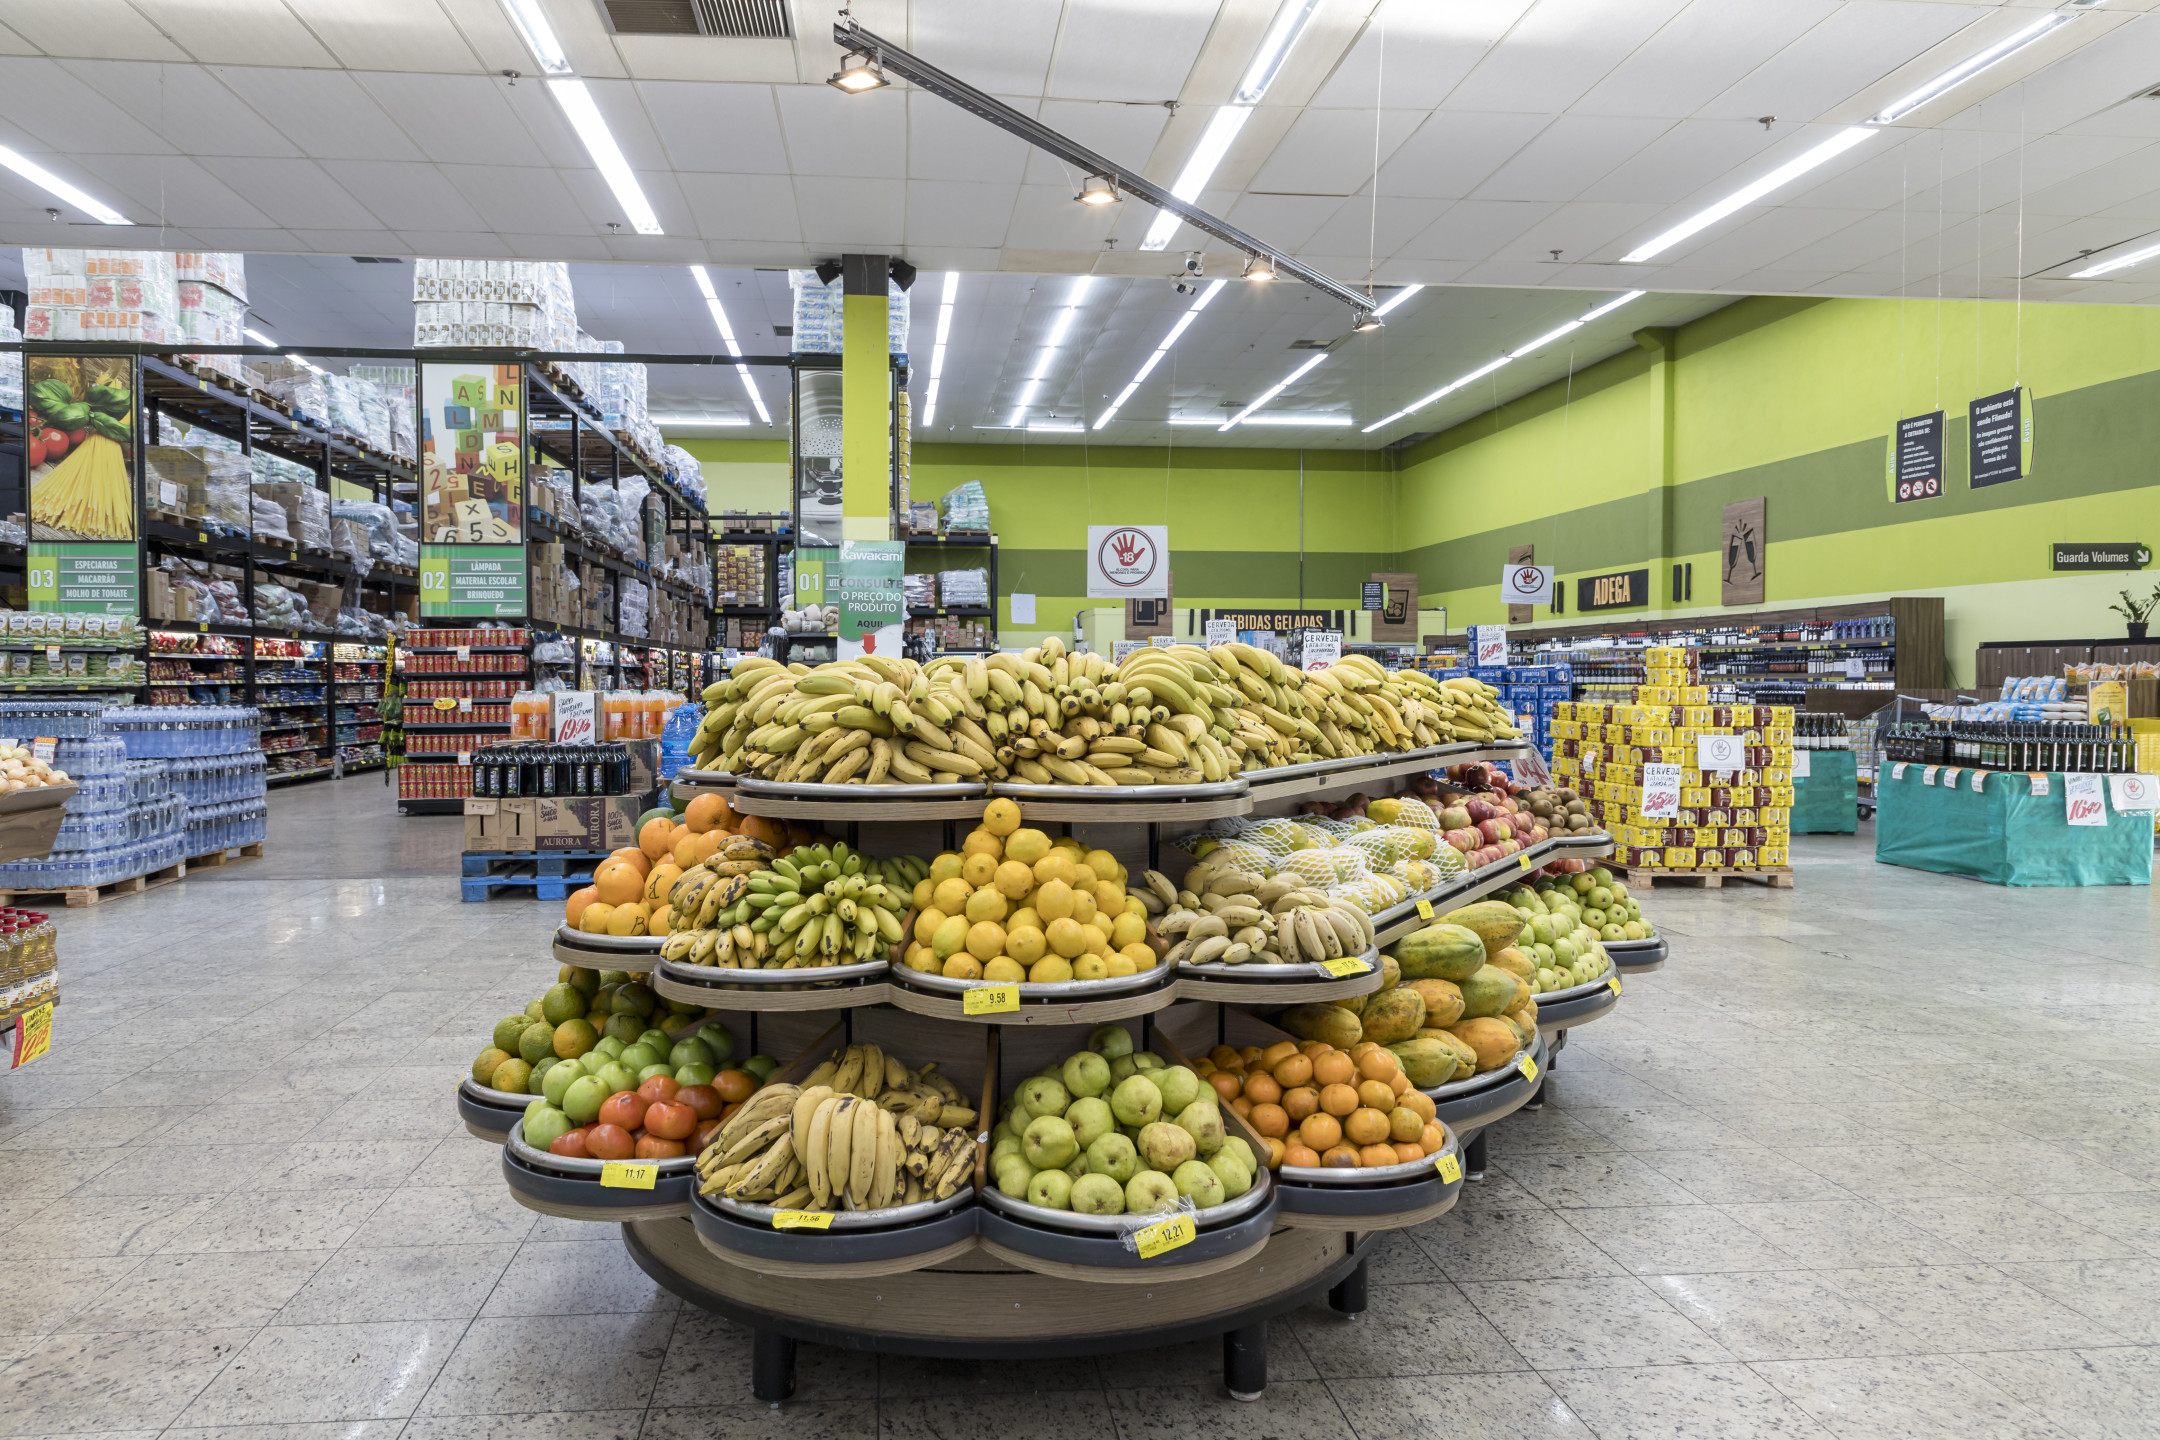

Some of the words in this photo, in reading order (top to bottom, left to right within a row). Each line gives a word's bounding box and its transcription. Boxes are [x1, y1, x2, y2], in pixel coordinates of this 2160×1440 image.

[457, 386, 470, 401] A
[477, 385, 484, 401] S
[500, 389, 514, 406] N
[452, 410, 464, 425] L
[483, 413, 499, 428] M
[466, 435, 478, 449] D
[461, 457, 473, 470] N
[505, 459, 517, 476] H
[430, 469, 441, 491] 2
[473, 481, 486, 497] E
[465, 503, 480, 515] X
[470, 522, 483, 543] 5
[841, 549, 903, 561] Kawakami
[1120, 552, 1135, 563] -18
[2056, 551, 2089, 563] Guarda
[2091, 551, 2129, 563] Volumes
[75, 561, 118, 569] ESPECIARIAS
[30, 569, 54, 588] 03
[78, 573, 116, 583] MACARRÃO
[422, 571, 446, 589] 02
[456, 577, 487, 585] MATERIAL
[489, 577, 517, 585] ESCOLAR
[799, 573, 819, 591] 01
[839, 578, 903, 589] CONSULTE
[66, 589, 90, 598] MOLHO
[91, 589, 100, 598] DE
[102, 589, 128, 598] TOMATE
[467, 591, 504, 599] BRINQUEDO
[1593, 575, 1631, 606] ADEGA
[841, 592, 849, 600] O
[851, 592, 883, 603] PREÇO
[886, 592, 901, 602] DO
[848, 603, 897, 612] PRODUTO
[857, 620, 883, 628] AQUI!
[1207, 621, 1235, 629] CERVEJA
[1275, 614, 1323, 631] GELADAS
[1304, 634, 1339, 642] CERVEJA
[1646, 767, 1680, 775] CERVEJA
[590, 801, 600, 847] AURORA
[543, 838, 581, 846] AURORA
[989, 992, 1006, 1004] 9.58
[625, 1168, 646, 1179] 11.17
[1162, 1224, 1184, 1241] 12.21
